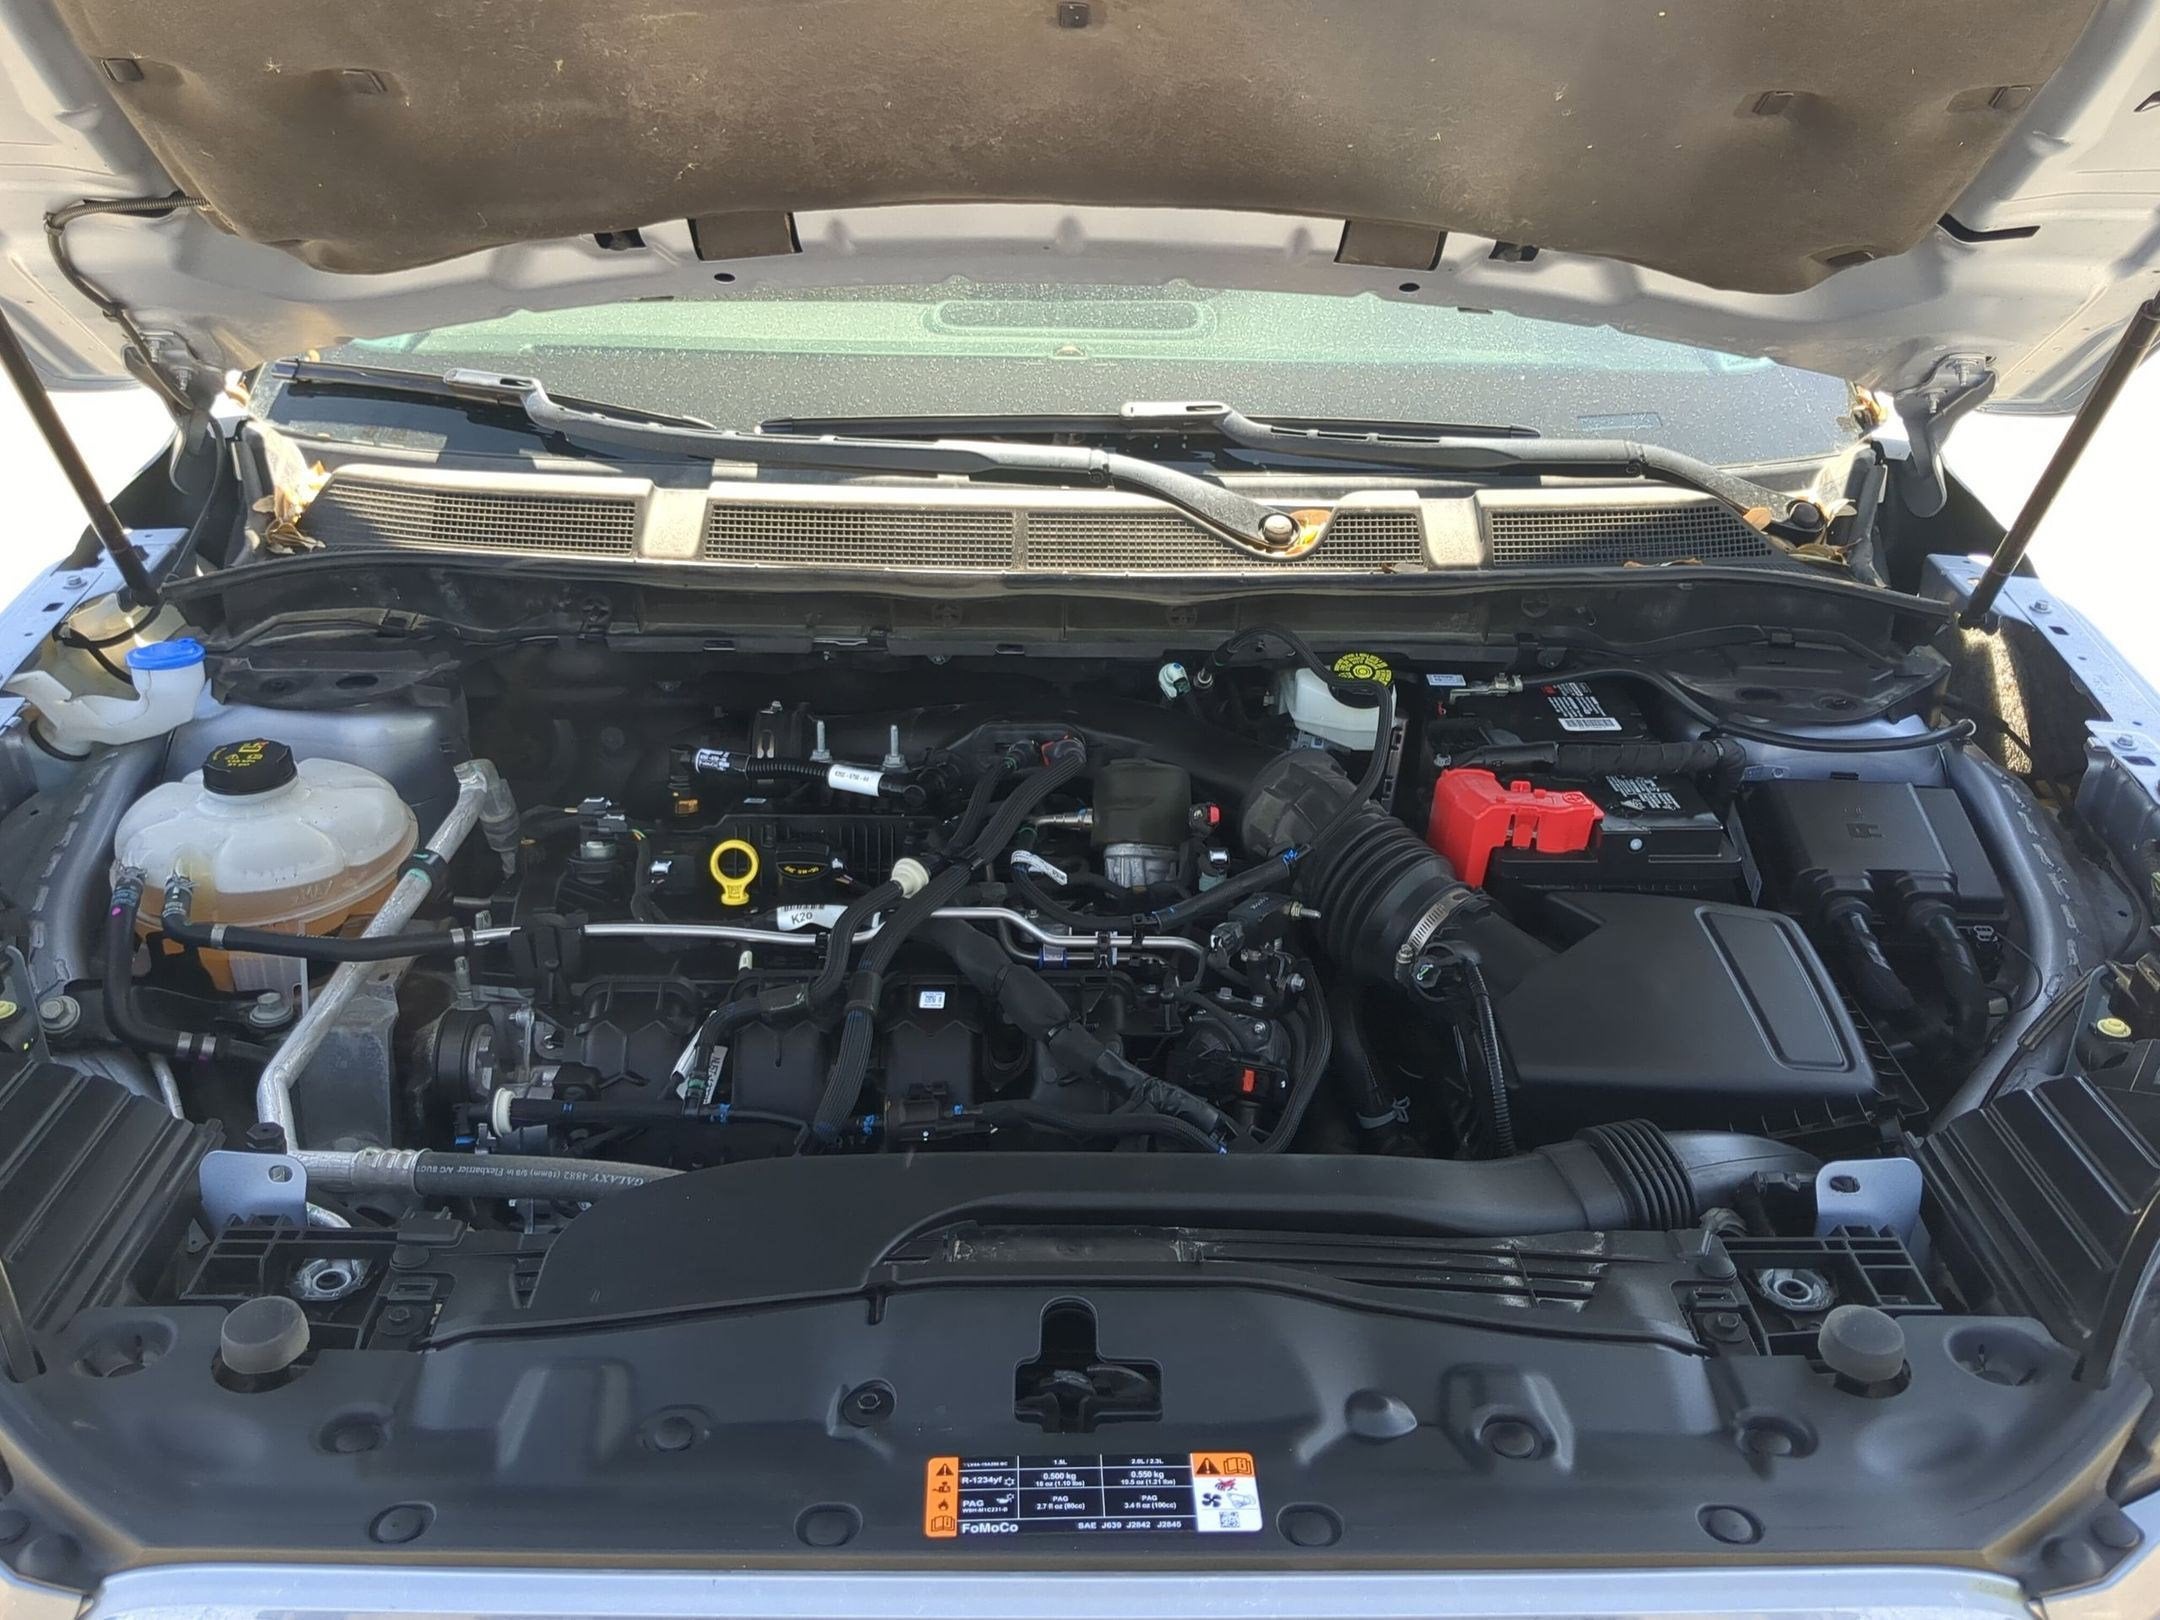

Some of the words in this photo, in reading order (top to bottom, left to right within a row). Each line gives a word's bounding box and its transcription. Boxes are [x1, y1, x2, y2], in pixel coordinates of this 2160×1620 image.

[457, 1166, 504, 1177] Flexbarrier
[563, 1171, 589, 1181] 4882
[591, 1173, 644, 1187] GALAXY
[1066, 1472, 1077, 1481] kg
[1153, 1470, 1165, 1479] kg
[961, 1476, 1003, 1485] R-1234yf
[1054, 1480, 1071, 1488] (1.10
[1151, 1502, 1177, 1510] (100cc)
[962, 1522, 1019, 1534] FoMoCo
[1078, 1522, 1097, 1530] SAE
[1101, 1521, 1122, 1529] J639
